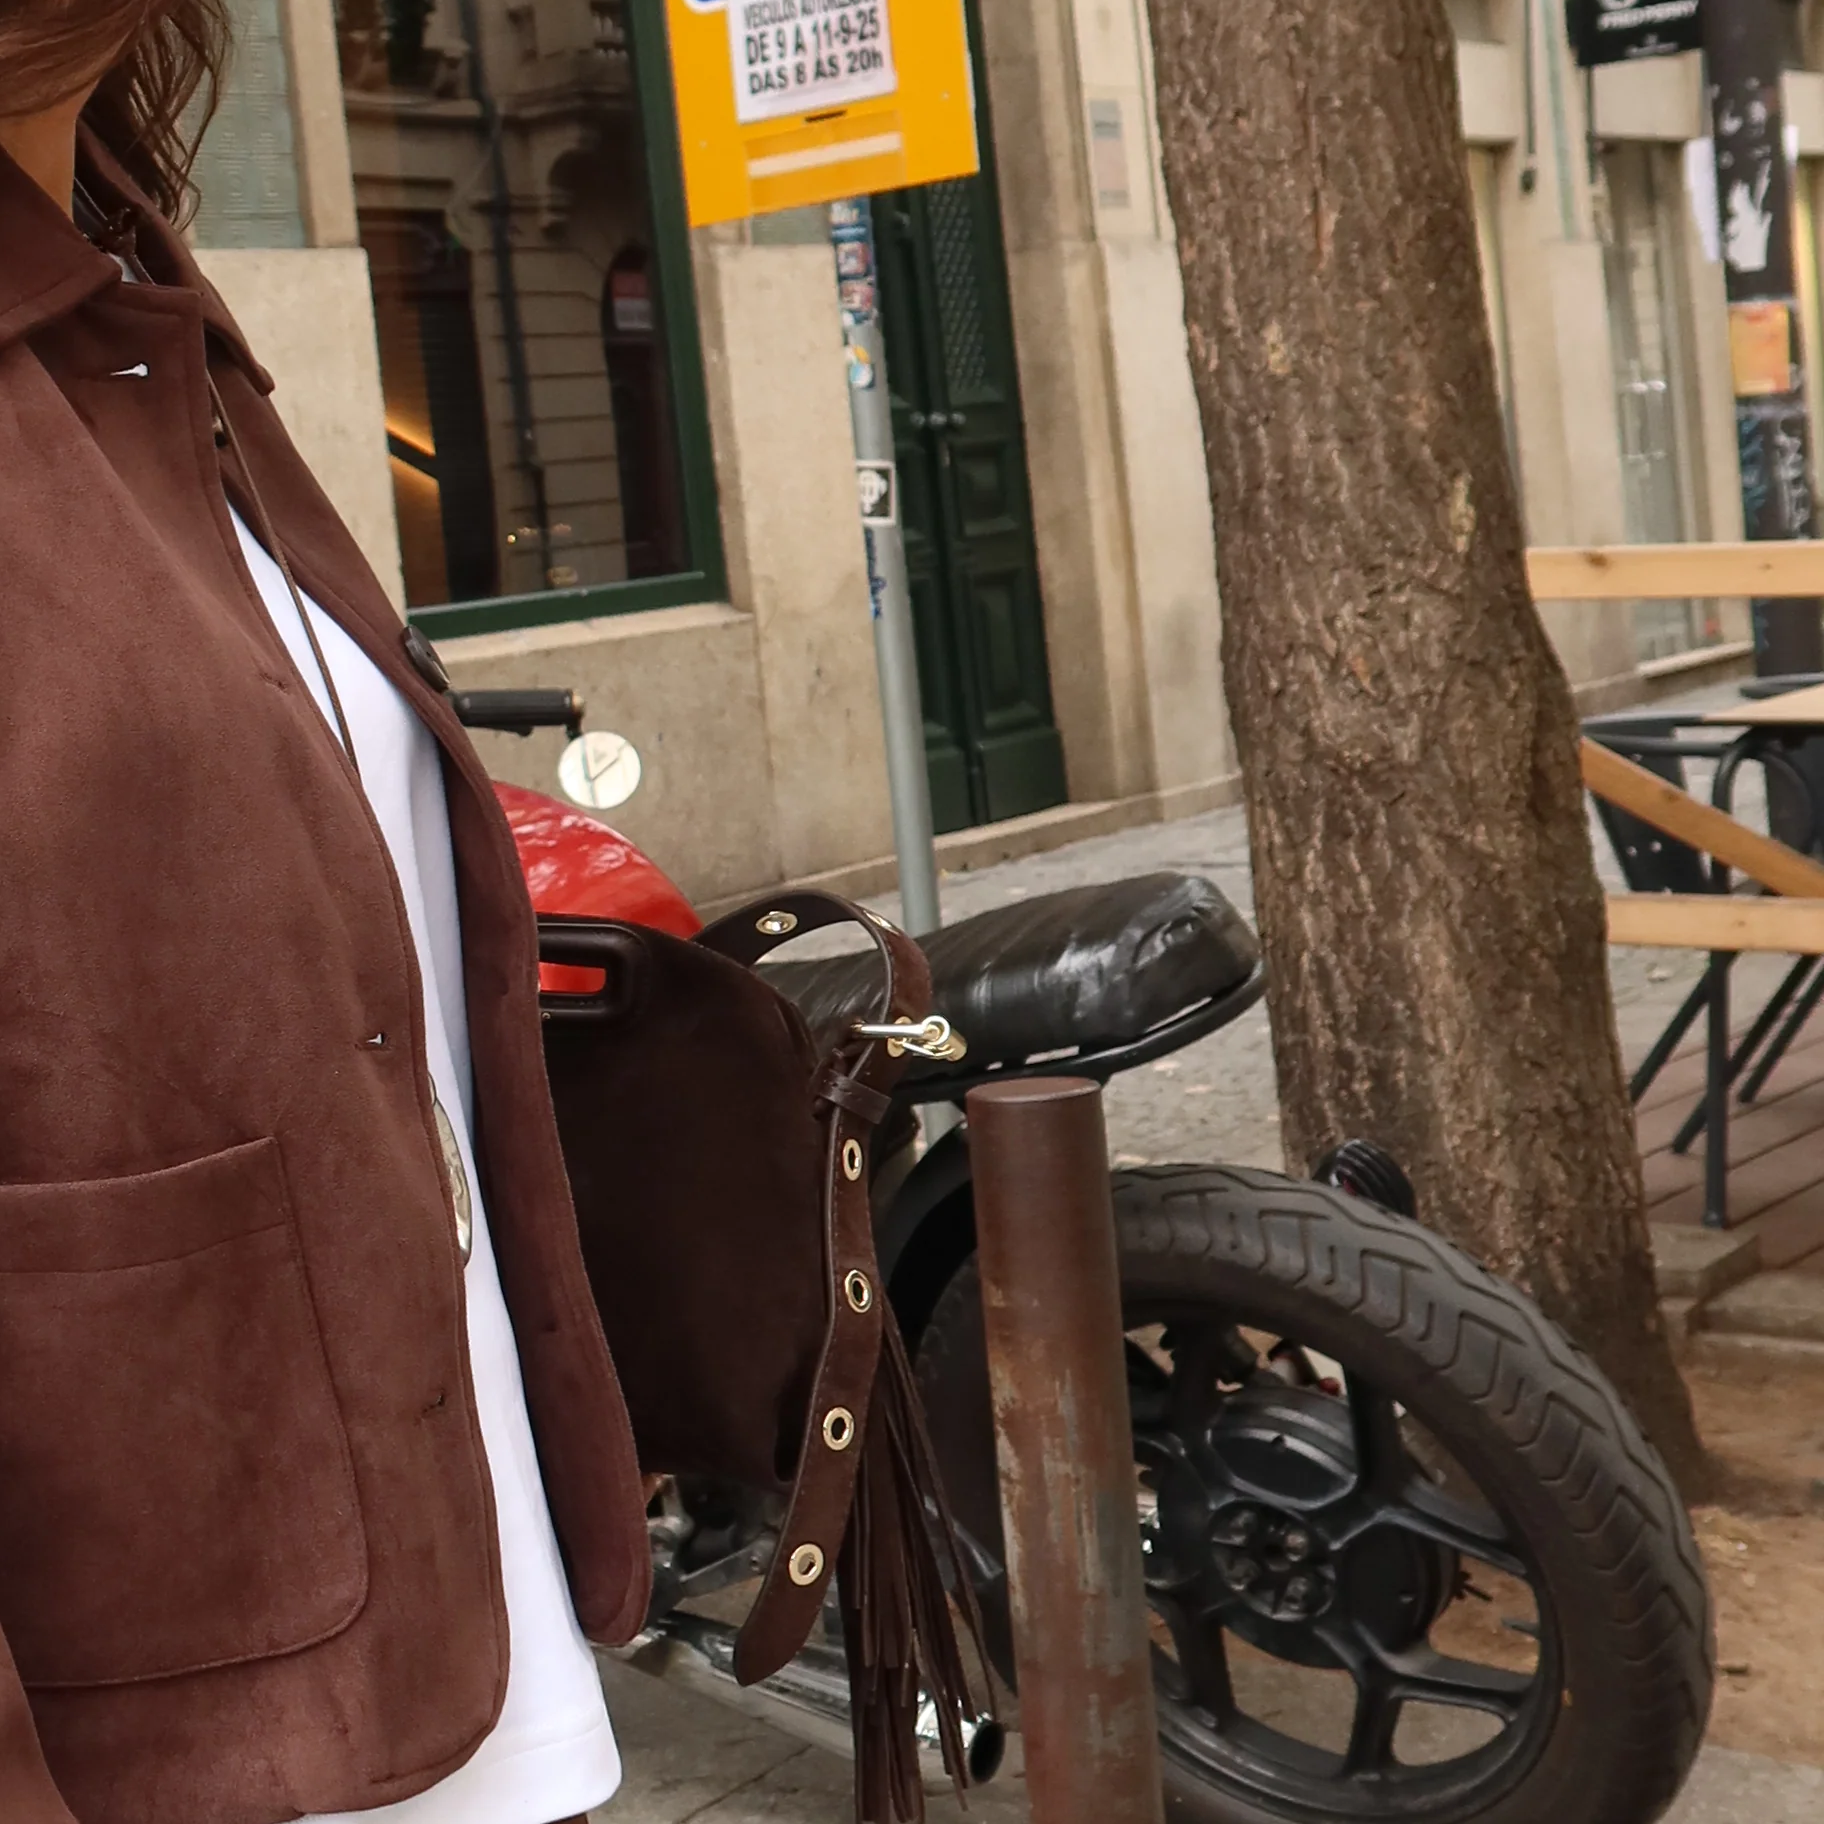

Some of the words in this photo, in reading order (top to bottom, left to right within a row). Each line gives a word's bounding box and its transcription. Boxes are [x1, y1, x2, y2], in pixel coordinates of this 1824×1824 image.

[745, 31, 771, 66] DE
[777, 28, 787, 59] 9
[794, 24, 806, 56] A
[811, 7, 880, 52] 11-9-25
[749, 65, 789, 95] DAS
[794, 61, 806, 85] 8
[846, 45, 884, 74] 20h
